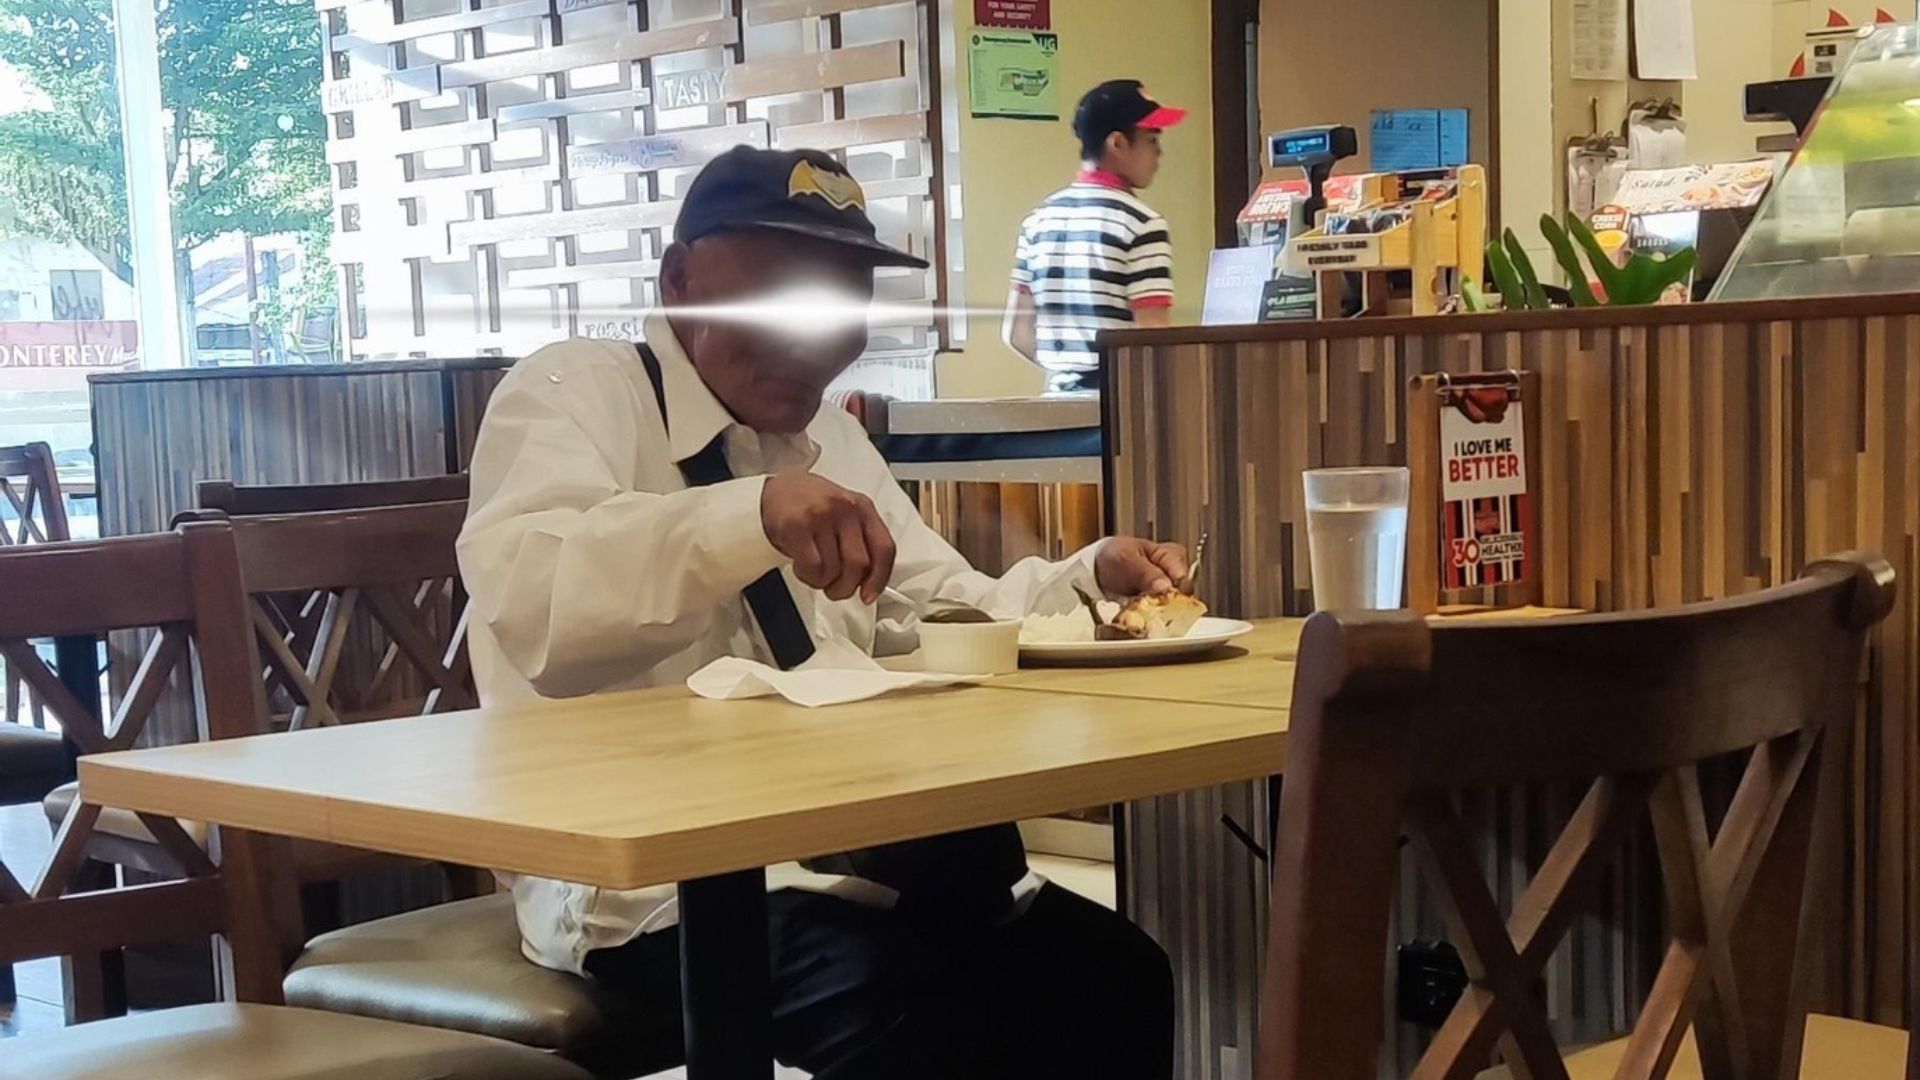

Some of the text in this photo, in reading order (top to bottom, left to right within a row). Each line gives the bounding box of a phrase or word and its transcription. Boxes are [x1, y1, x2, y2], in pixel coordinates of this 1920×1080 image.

[663, 69, 729, 108] TASTY
[1454, 438, 1513, 456] I LOVE ME
[1448, 454, 1519, 482] BETTER
[1452, 540, 1480, 565] 30
